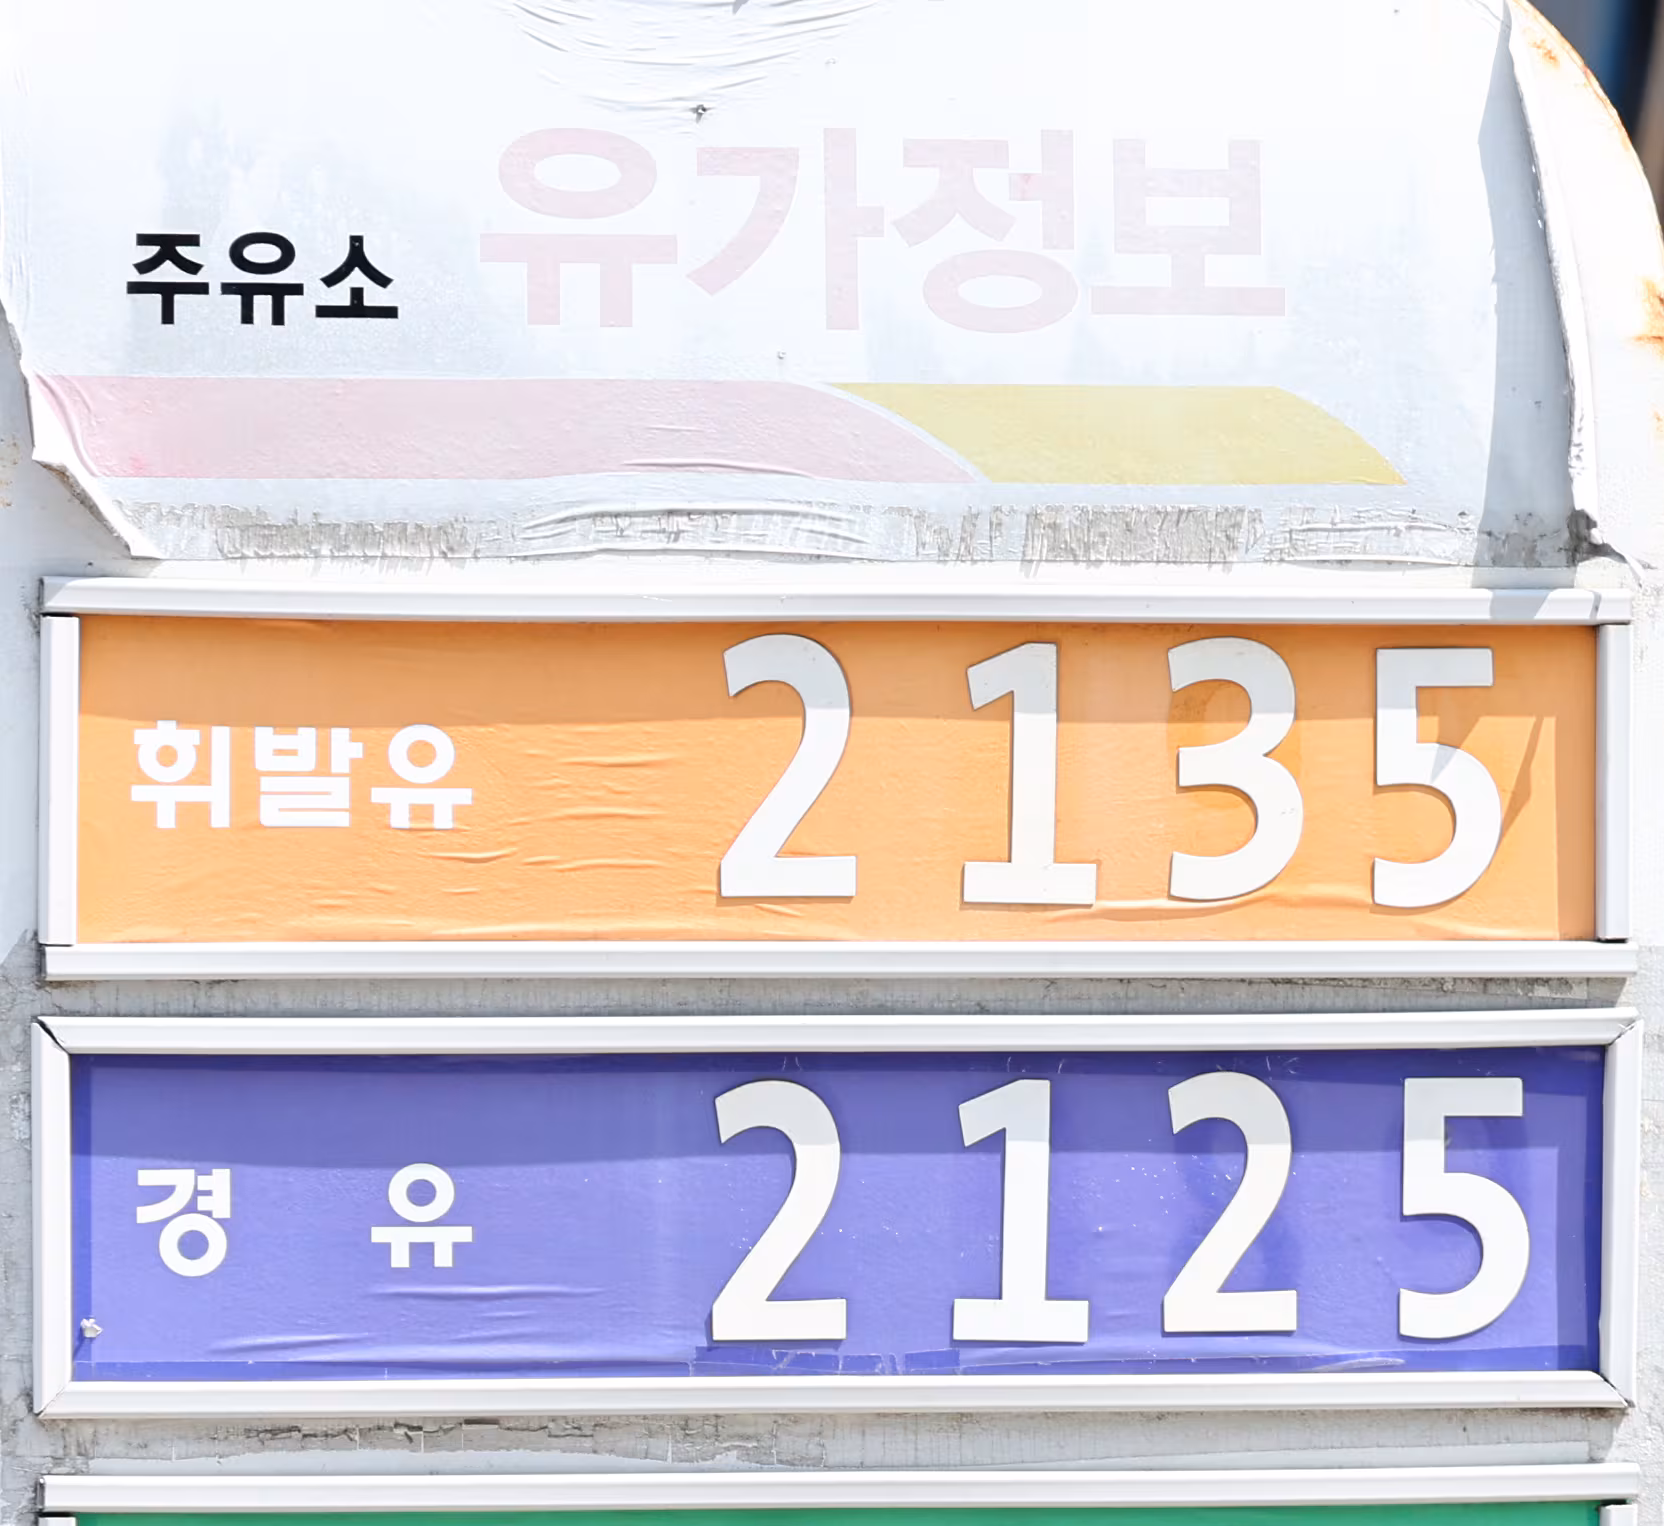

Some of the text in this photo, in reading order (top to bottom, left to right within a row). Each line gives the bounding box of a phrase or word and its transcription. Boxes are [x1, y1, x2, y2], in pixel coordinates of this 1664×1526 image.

[127, 232, 399, 326] 주유소
[480, 127, 1286, 334] 유가정보
[130, 634, 1503, 910] 휘발유 2135
[712, 1072, 1530, 1344] 2125
